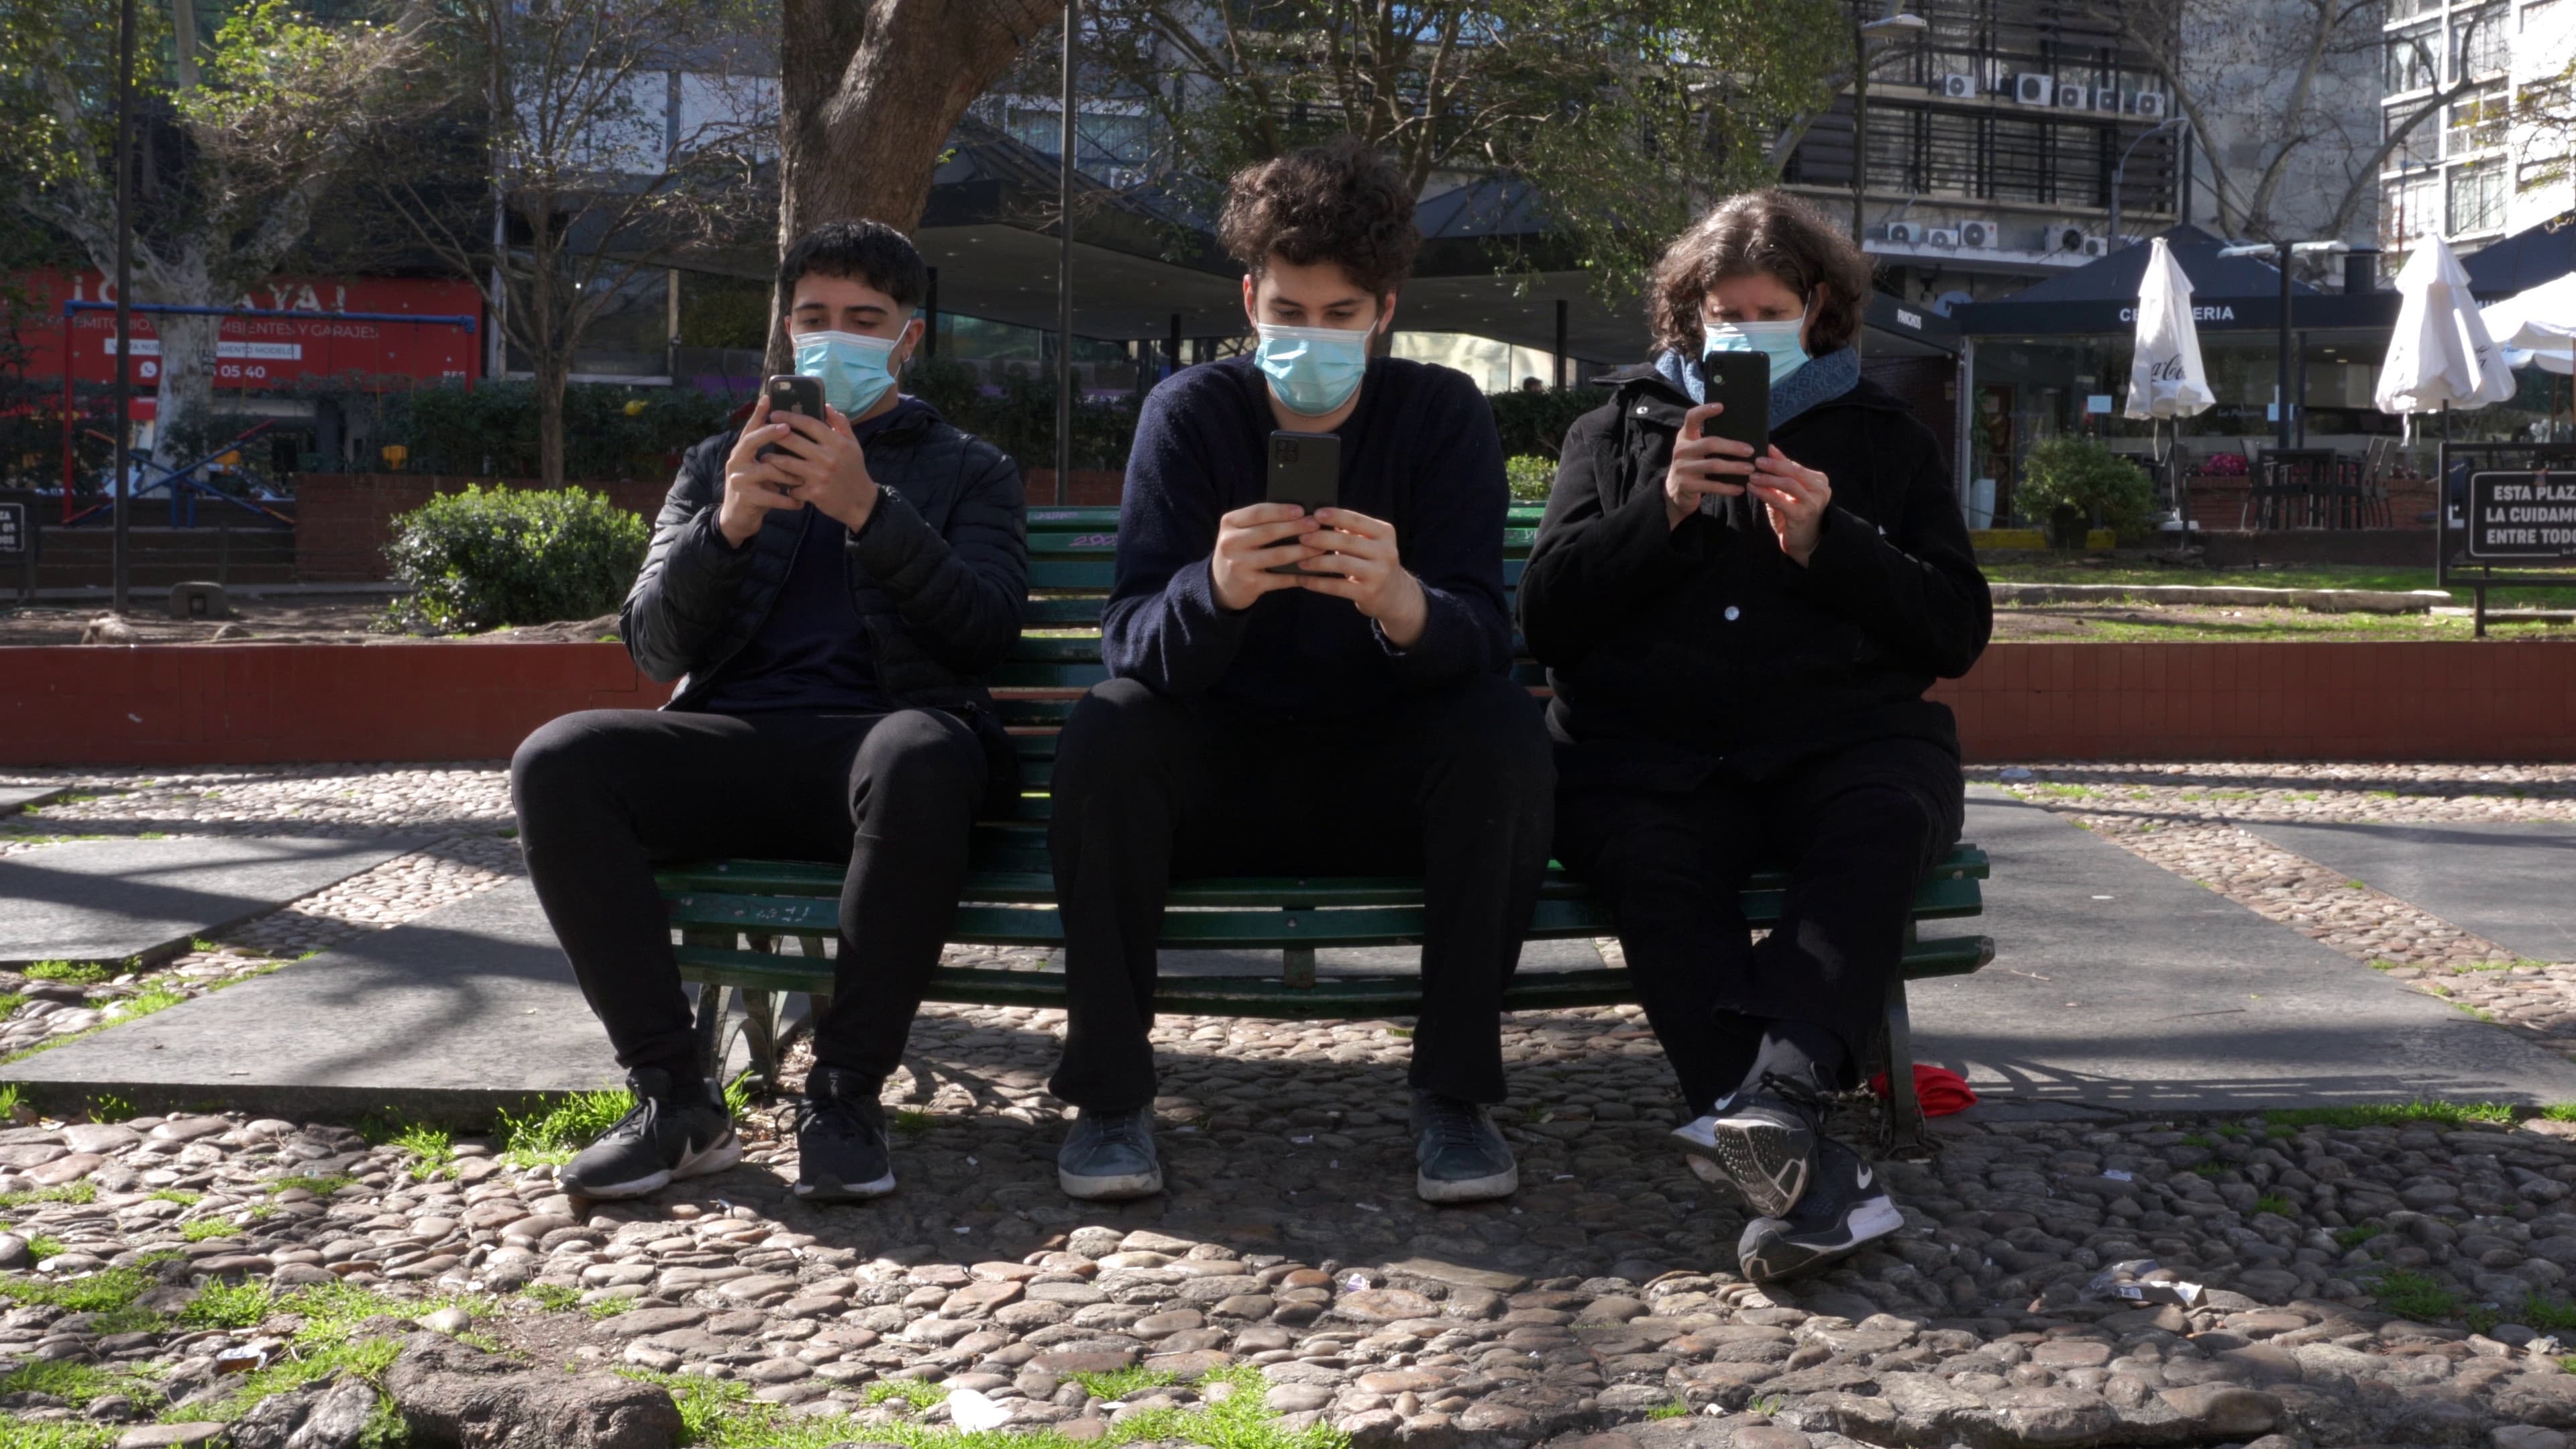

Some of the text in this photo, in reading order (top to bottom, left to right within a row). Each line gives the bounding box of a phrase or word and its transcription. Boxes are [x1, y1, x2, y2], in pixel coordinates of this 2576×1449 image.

[2120, 307, 2235, 321] CEERIA
[221, 365, 266, 378] 05 40
[2494, 486, 2532, 500] ESTA
[2486, 507, 2576, 522] LA CUIDAM
[2487, 529, 2536, 543] ENTRE
